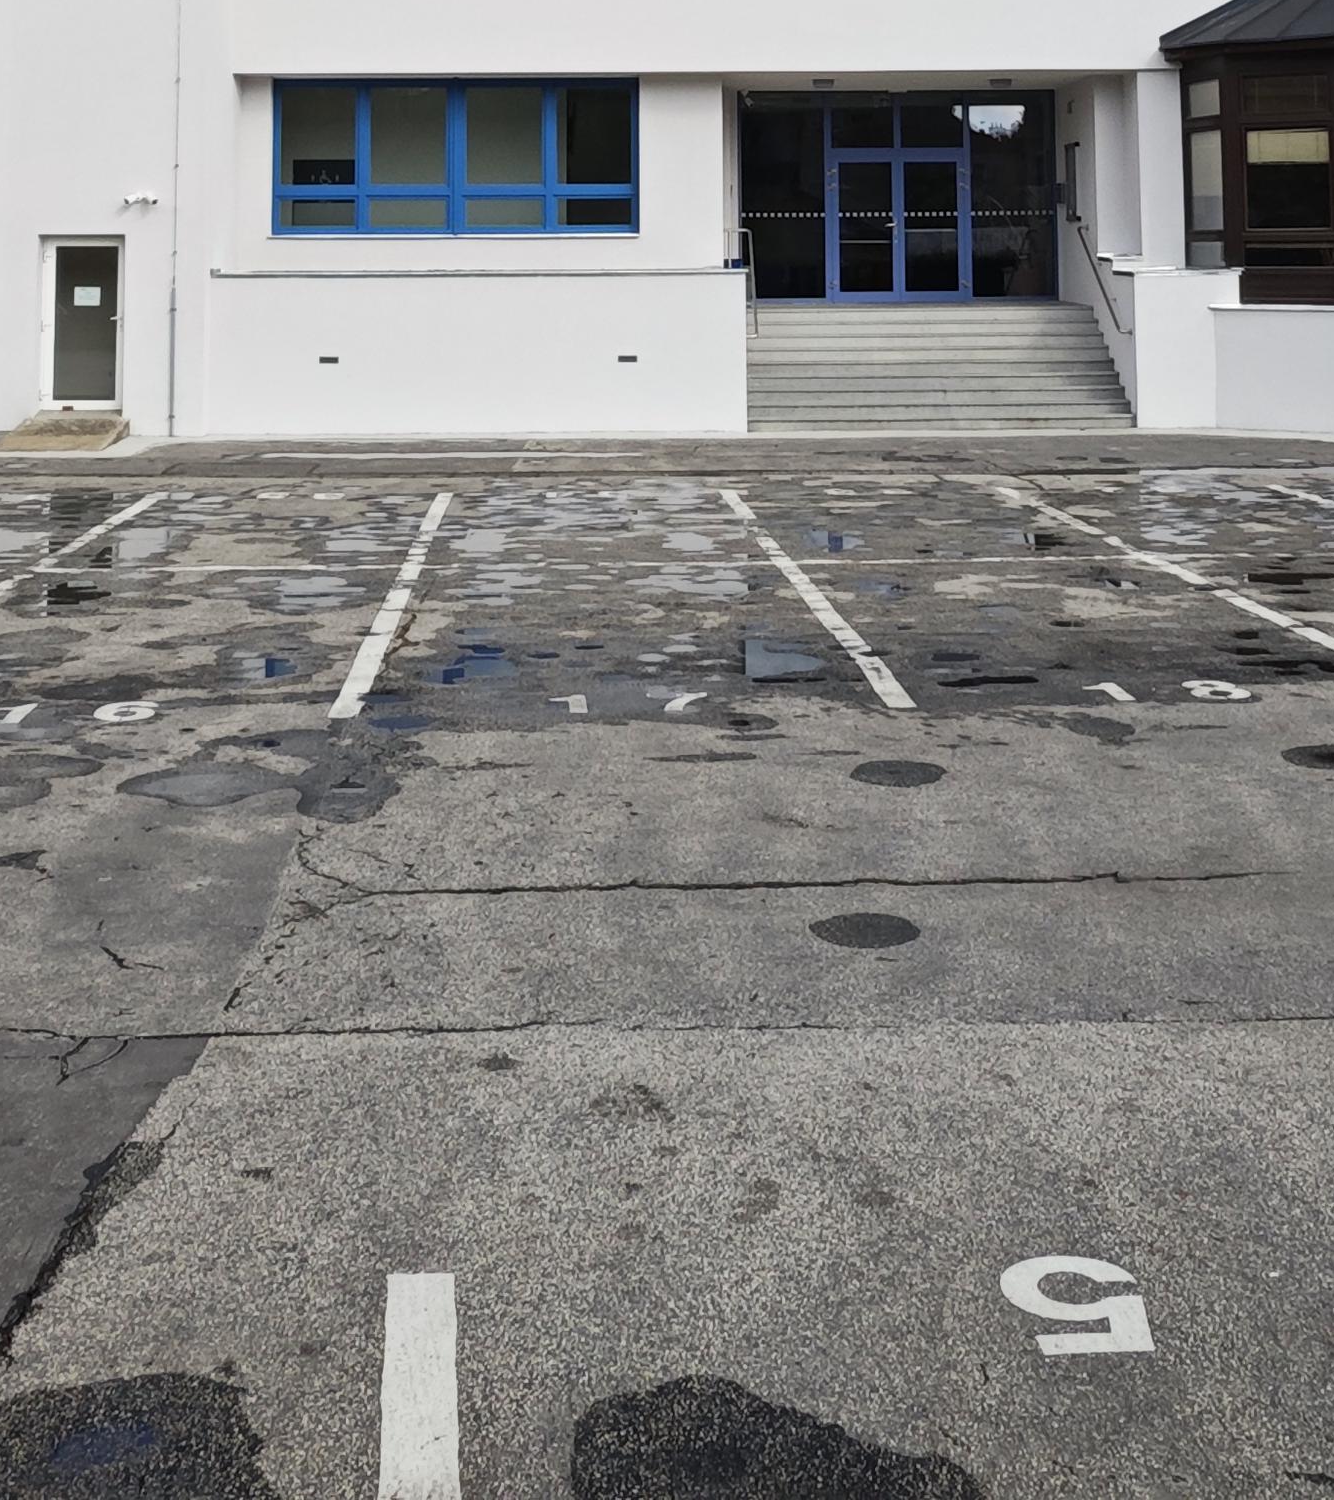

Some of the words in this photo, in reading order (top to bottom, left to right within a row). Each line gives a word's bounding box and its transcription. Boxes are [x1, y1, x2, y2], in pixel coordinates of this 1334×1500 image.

[1082, 680, 1252, 700] 18
[549, 692, 708, 714] 17
[1000, 1255, 1156, 1356] 5
